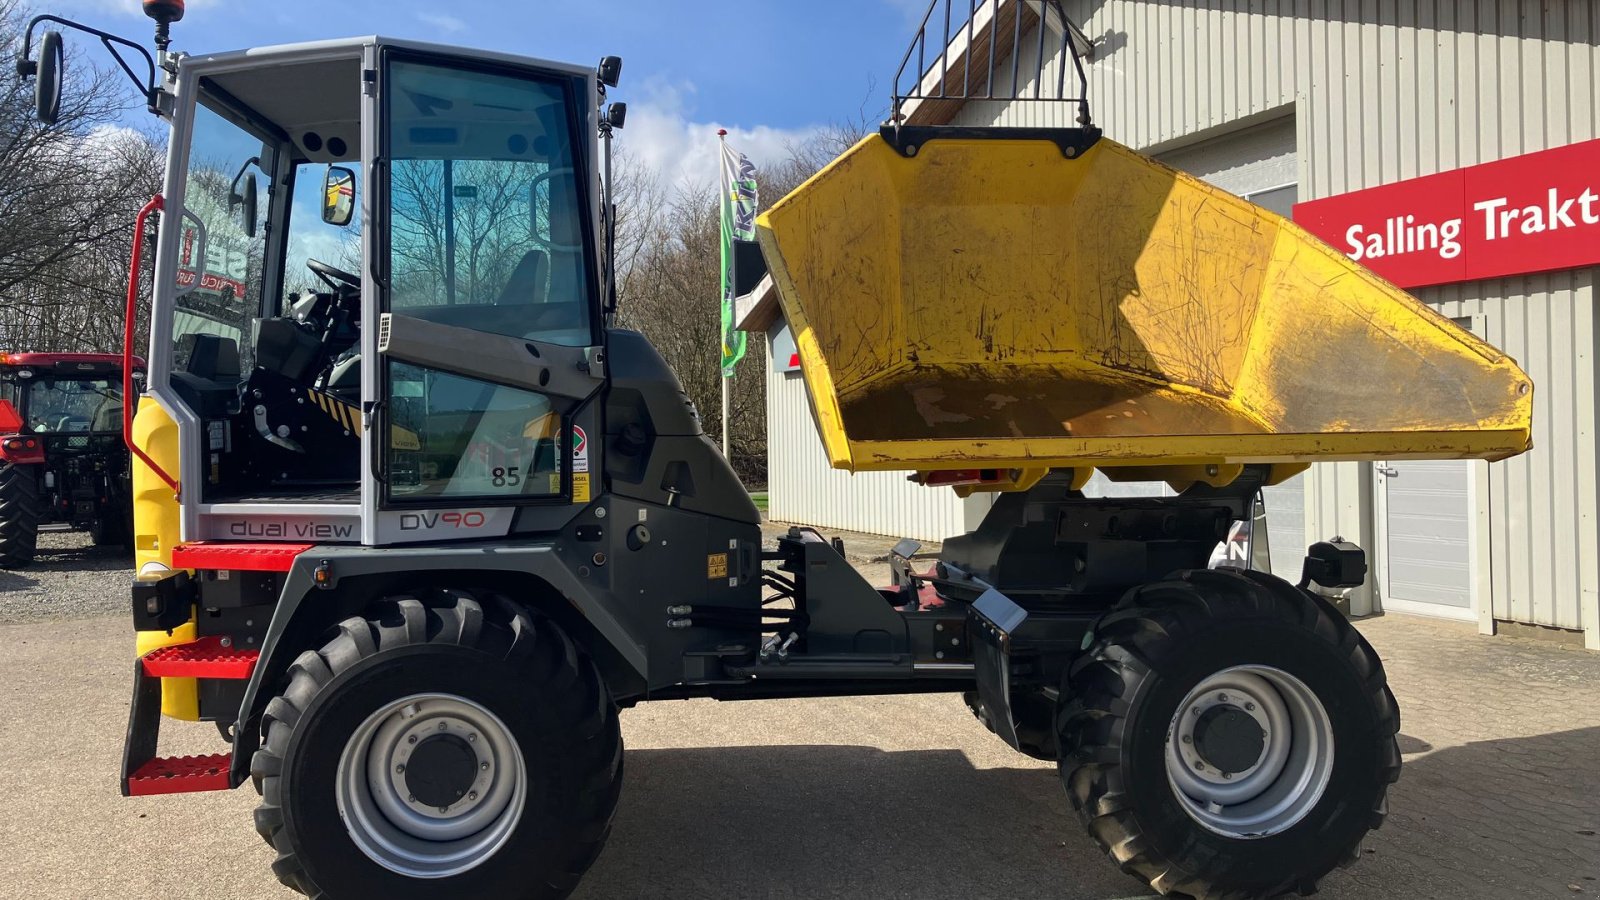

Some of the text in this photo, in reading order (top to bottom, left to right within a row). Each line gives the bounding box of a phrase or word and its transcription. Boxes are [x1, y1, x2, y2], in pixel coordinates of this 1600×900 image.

[1345, 186, 1600, 261] Salling Trakt
[492, 466, 520, 488] 85
[230, 520, 353, 538] dual view
[400, 511, 485, 531] DV90
